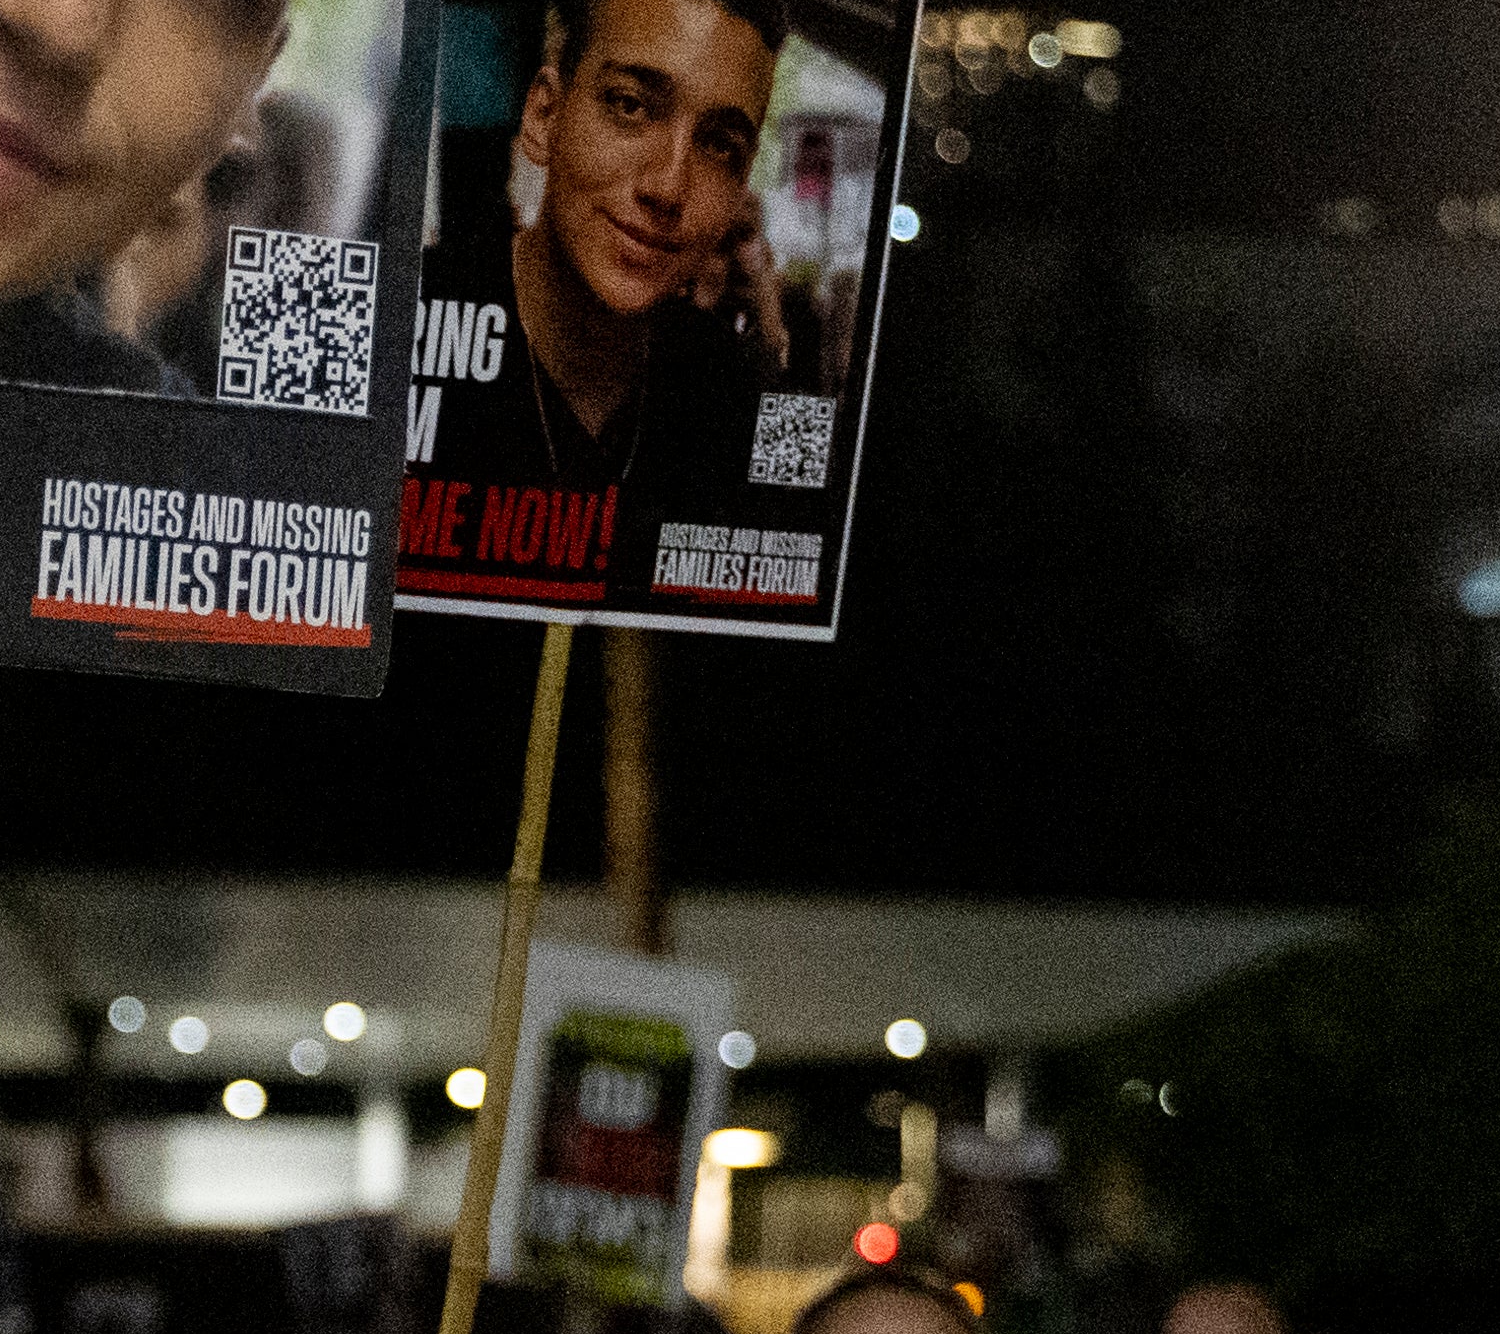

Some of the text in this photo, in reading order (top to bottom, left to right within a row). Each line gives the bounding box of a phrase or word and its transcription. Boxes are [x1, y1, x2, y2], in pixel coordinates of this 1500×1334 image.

[410, 298, 508, 383] ING
[42, 478, 371, 558] HOSTAGES AND MISSING
[400, 478, 618, 570] ME NOW!
[38, 531, 369, 631] FAMILIES FORUM
[654, 547, 819, 597] FAMILIES FORUM
